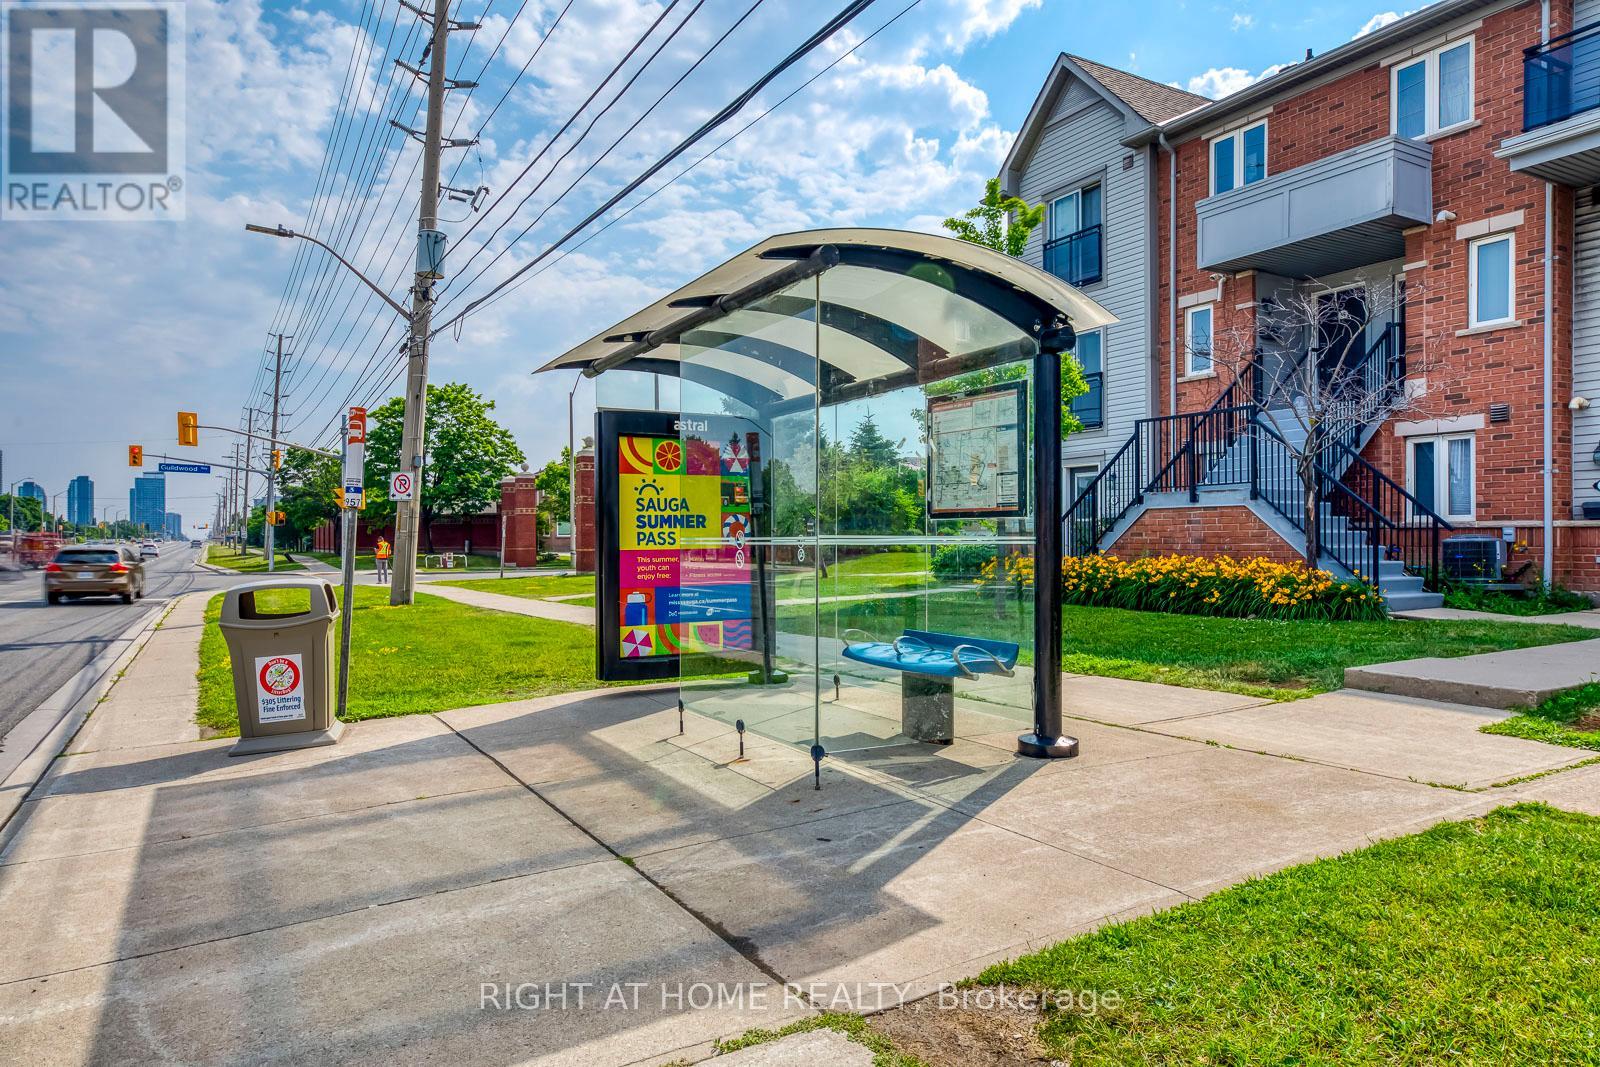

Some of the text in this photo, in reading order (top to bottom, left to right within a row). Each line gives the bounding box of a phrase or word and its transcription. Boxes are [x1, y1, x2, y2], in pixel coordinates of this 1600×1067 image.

[673, 420, 708, 432] astral
[160, 464, 198, 472] Guildwood
[636, 497, 690, 512] SAUGA
[636, 531, 676, 546] PASS
[637, 565, 657, 573] youth
[637, 573, 656, 581] enjoy
[276, 696, 302, 704] Littering
[276, 703, 301, 712] Enforced
